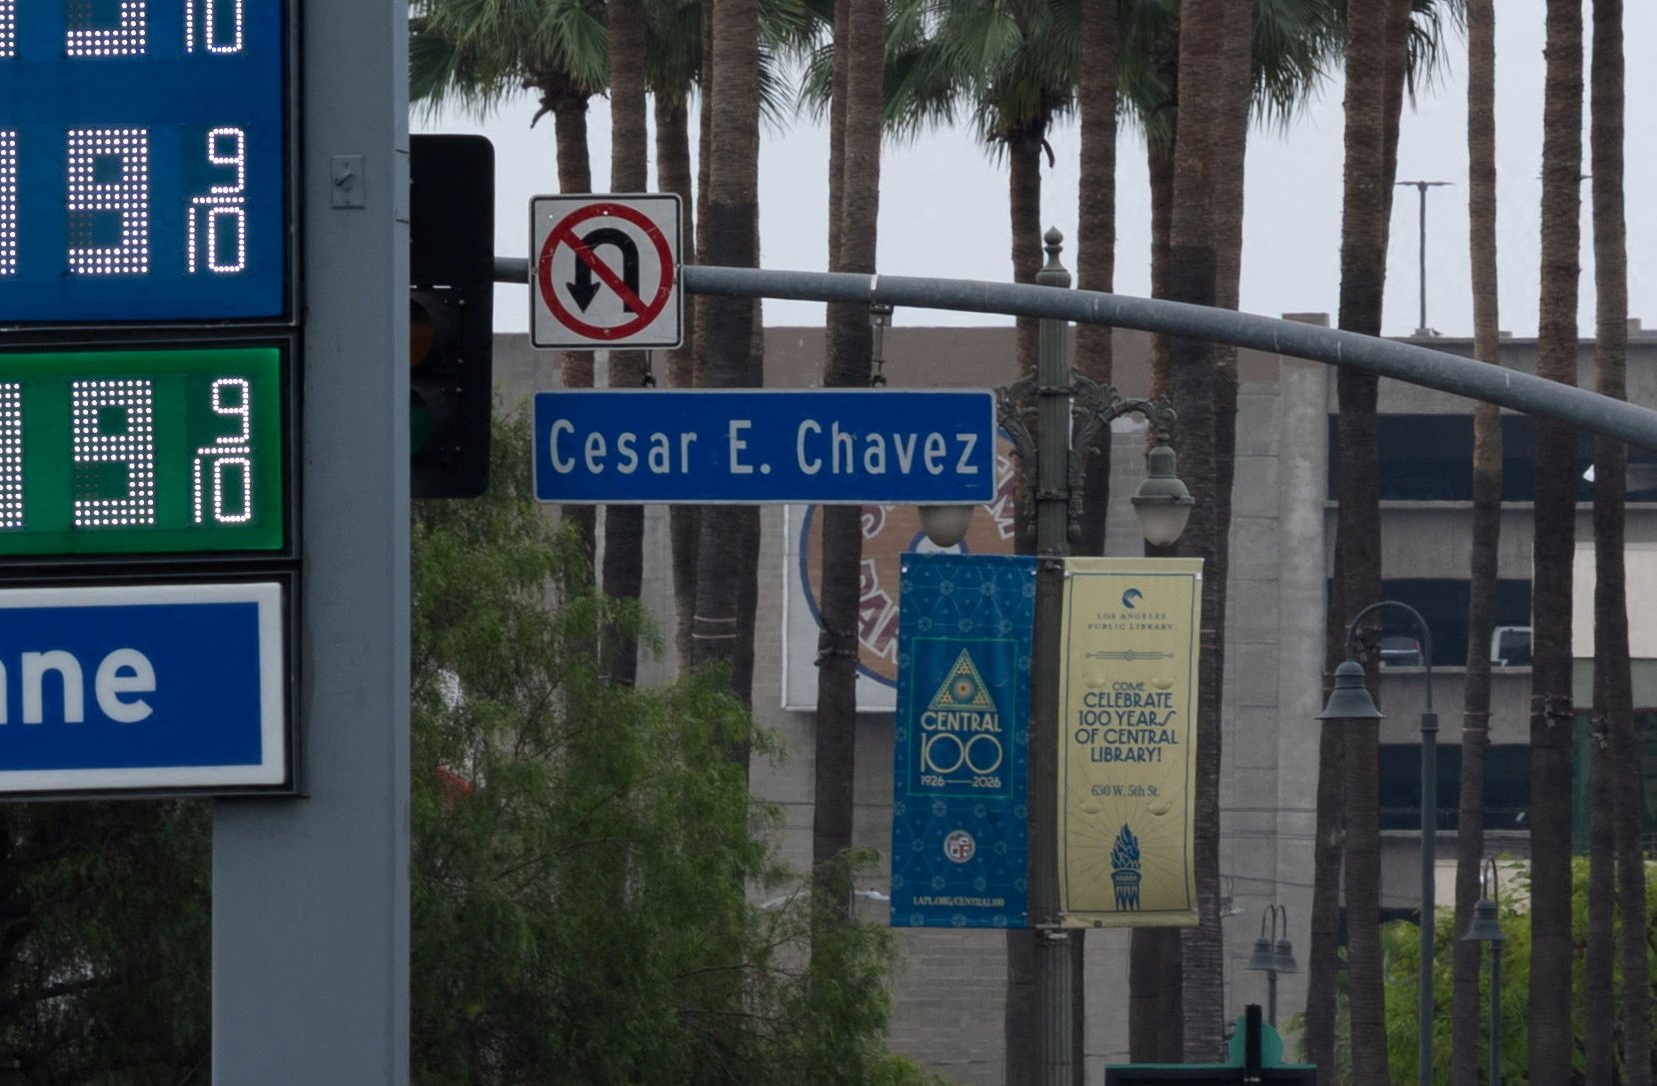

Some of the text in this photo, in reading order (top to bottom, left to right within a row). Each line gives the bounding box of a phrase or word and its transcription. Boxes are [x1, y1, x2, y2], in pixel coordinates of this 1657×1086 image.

[548, 418, 980, 476] Cesar E. Chavez
[1096, 612, 1167, 620] LOS ANGELES
[1087, 623, 1175, 631] PUBLIC LIBRARY
[1111, 681, 1145, 692] COME
[1083, 692, 1173, 709] CELEBRATE
[920, 711, 1003, 733] CENTRAL
[1078, 710, 1177, 727] 100 YEARS
[1074, 728, 1180, 745] OF CENTRAL
[920, 732, 1004, 775] 100
[1090, 746, 1162, 763] LIBRARY!
[920, 775, 1002, 789] 1926 2026
